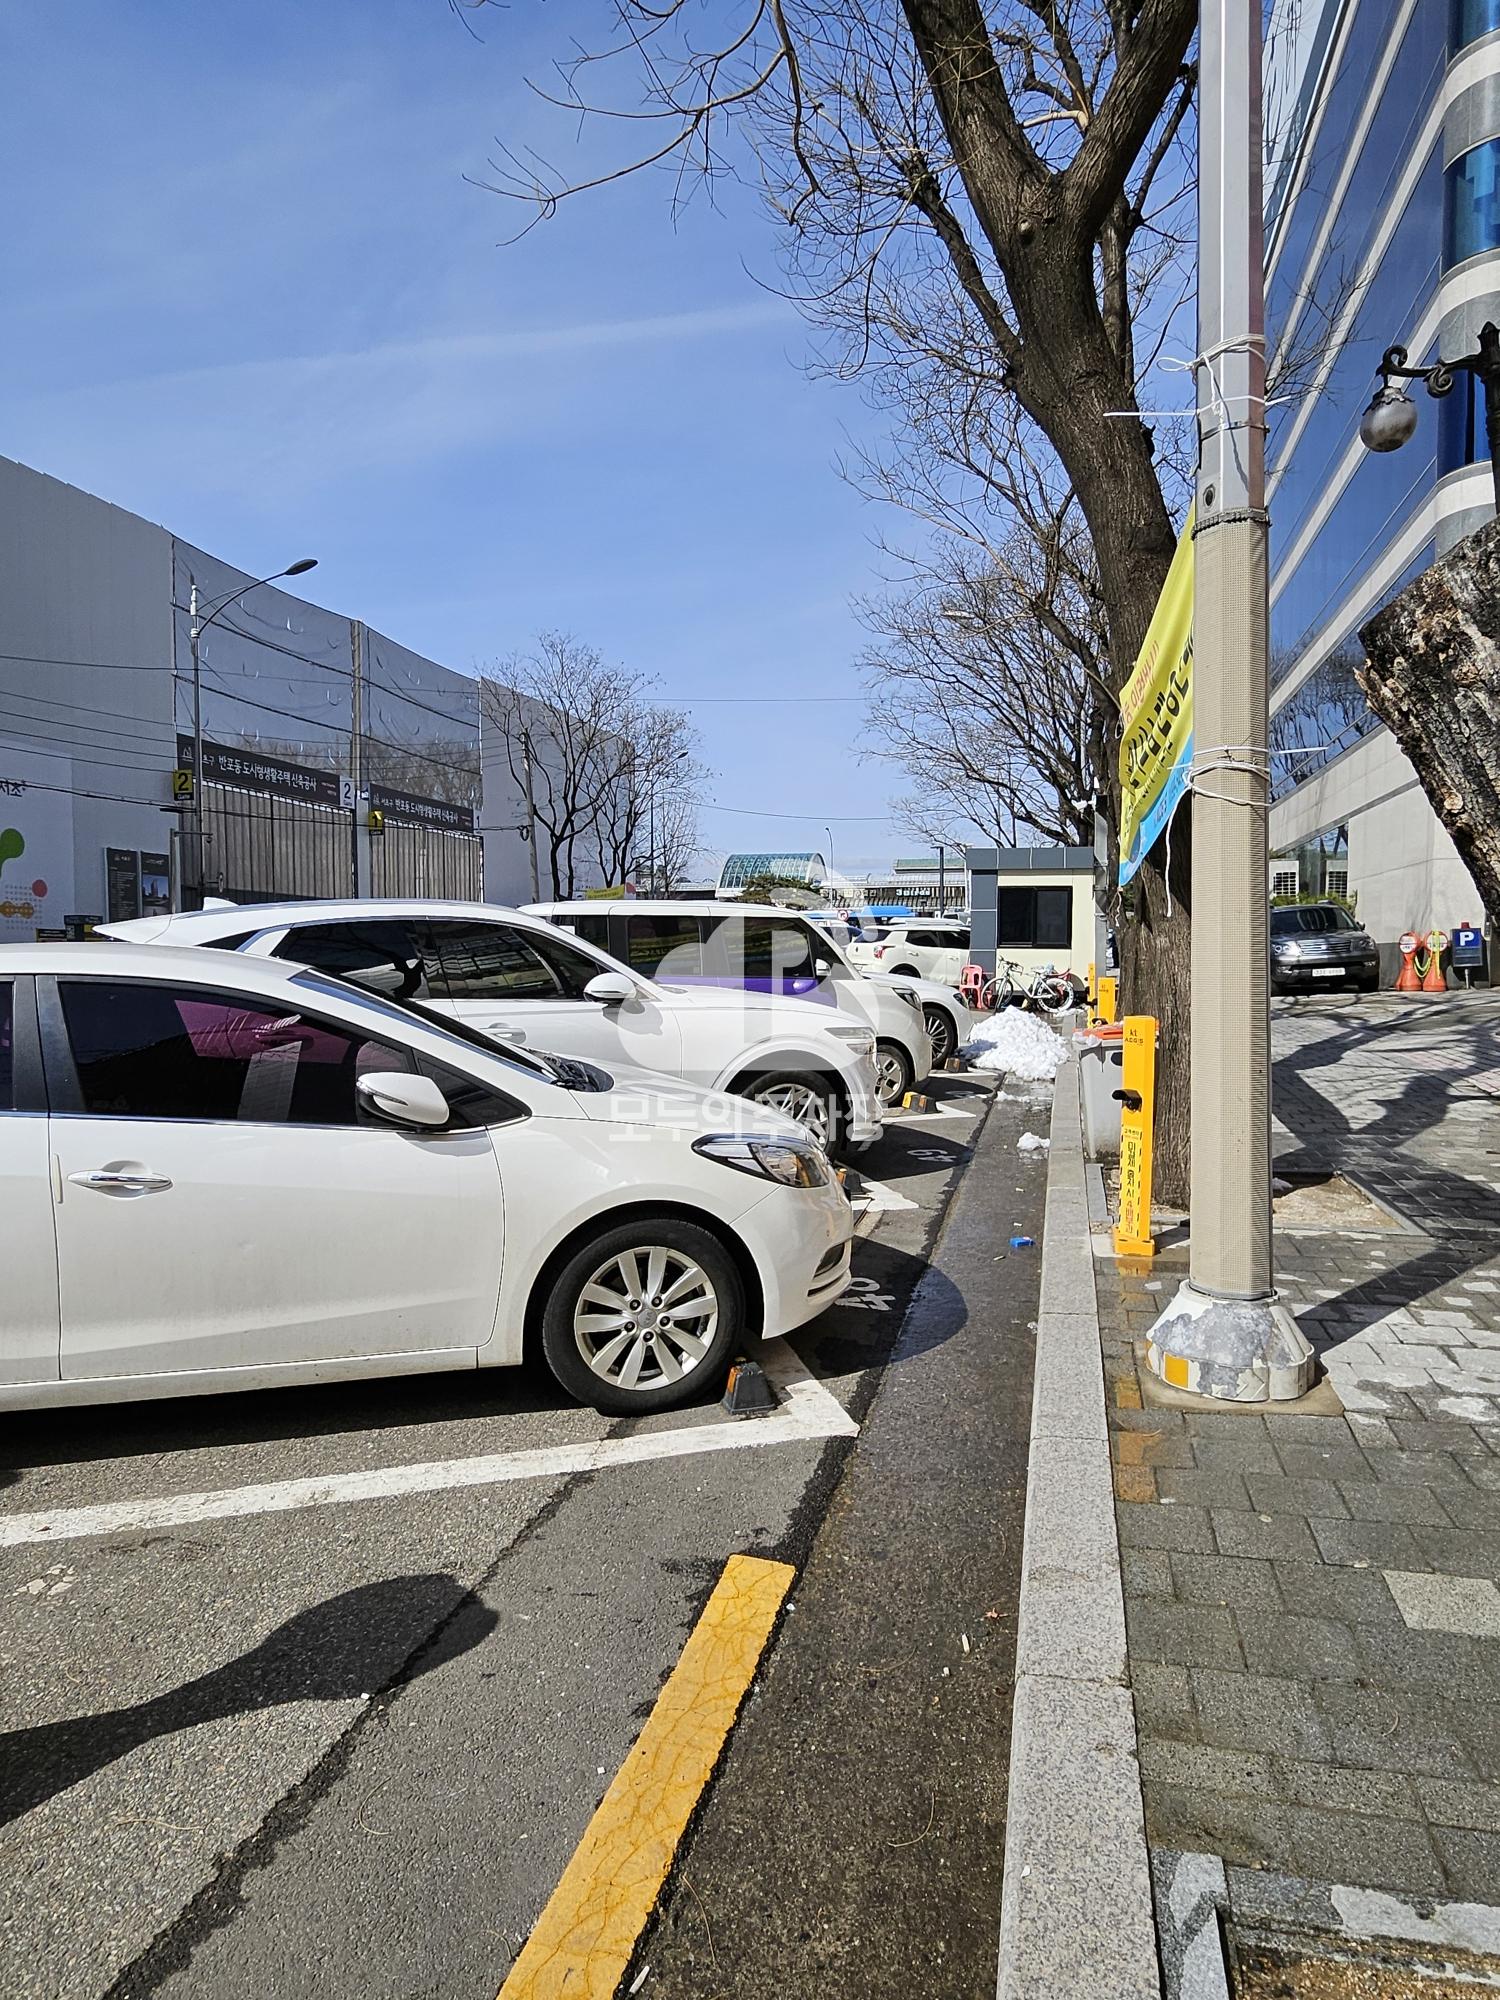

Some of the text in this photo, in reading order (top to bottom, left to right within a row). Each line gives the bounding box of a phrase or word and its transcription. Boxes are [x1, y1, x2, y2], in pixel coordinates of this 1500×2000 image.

[177, 772, 189, 791] 2
[218, 755, 242, 774] 반포동
[242, 762, 291, 786] 도시형생활주택
[291, 776, 317, 792] 신축공사
[344, 782, 352, 799] 2
[1459, 931, 1475, 946] P
